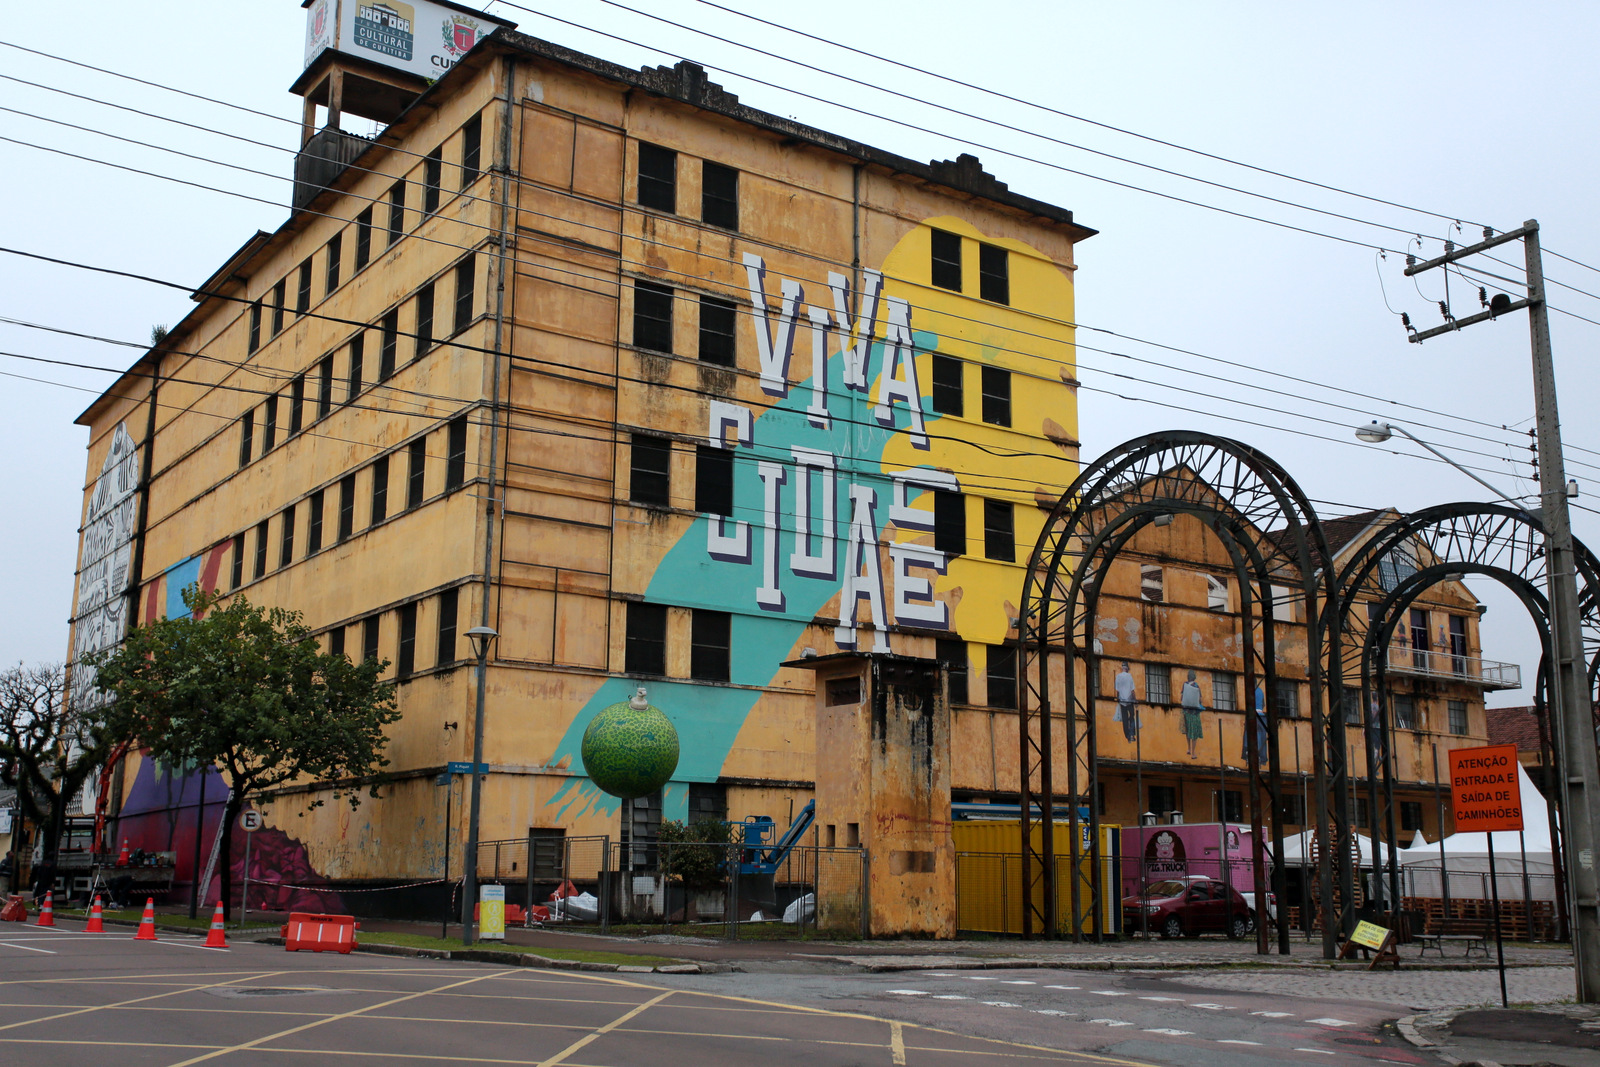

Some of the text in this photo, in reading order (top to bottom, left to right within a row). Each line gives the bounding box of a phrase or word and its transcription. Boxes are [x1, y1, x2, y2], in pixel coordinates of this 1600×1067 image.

[360, 27, 408, 50] CULTURAL
[360, 39, 407, 58] DE CURITIBA
[742, 251, 931, 452] VIVA
[1458, 755, 1508, 769] ATENÇÃO
[1455, 773, 1514, 786] ENTRADA E
[1461, 791, 1510, 803] SAÍDA DE
[1457, 806, 1519, 820] CAMINHÕES
